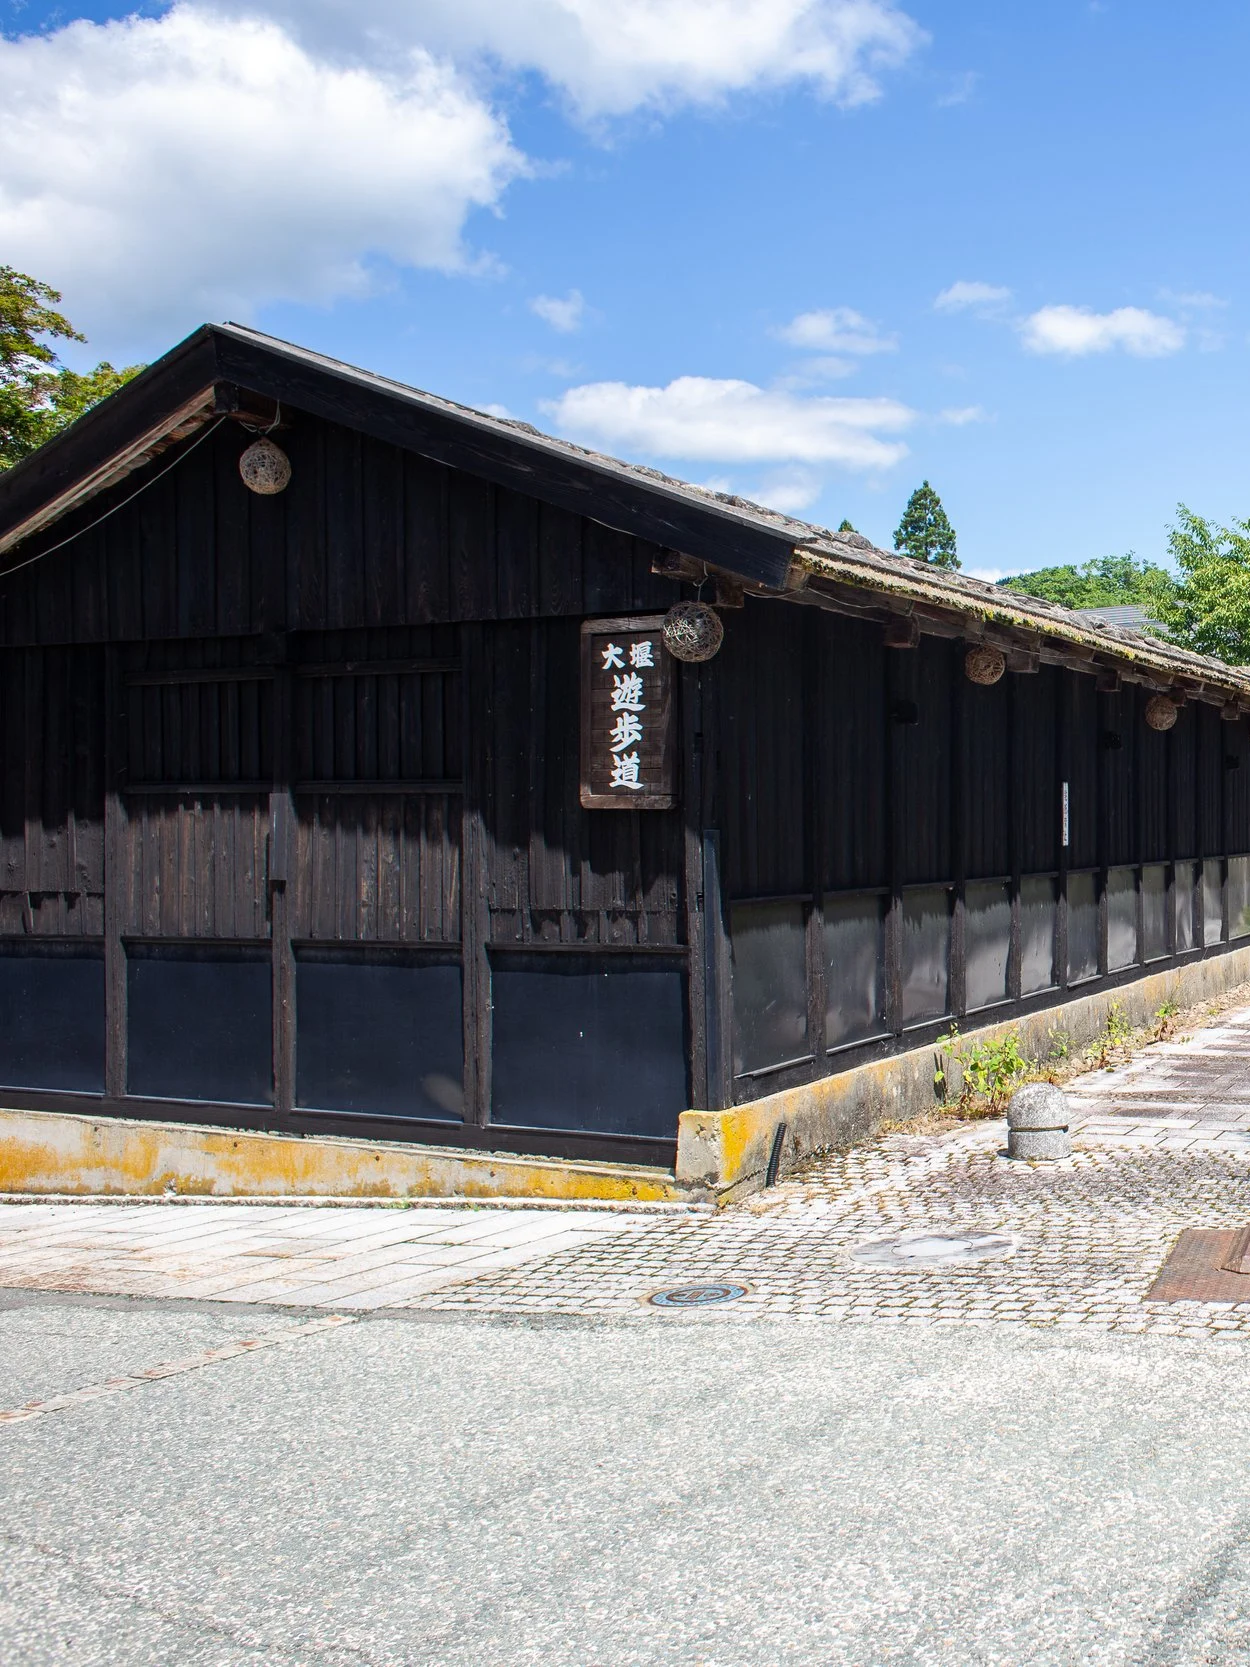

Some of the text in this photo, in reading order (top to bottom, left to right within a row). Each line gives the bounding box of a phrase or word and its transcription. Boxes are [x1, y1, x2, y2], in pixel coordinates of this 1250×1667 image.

[601, 640, 655, 670] 大堰
[608, 671, 646, 790] 遊歩道
